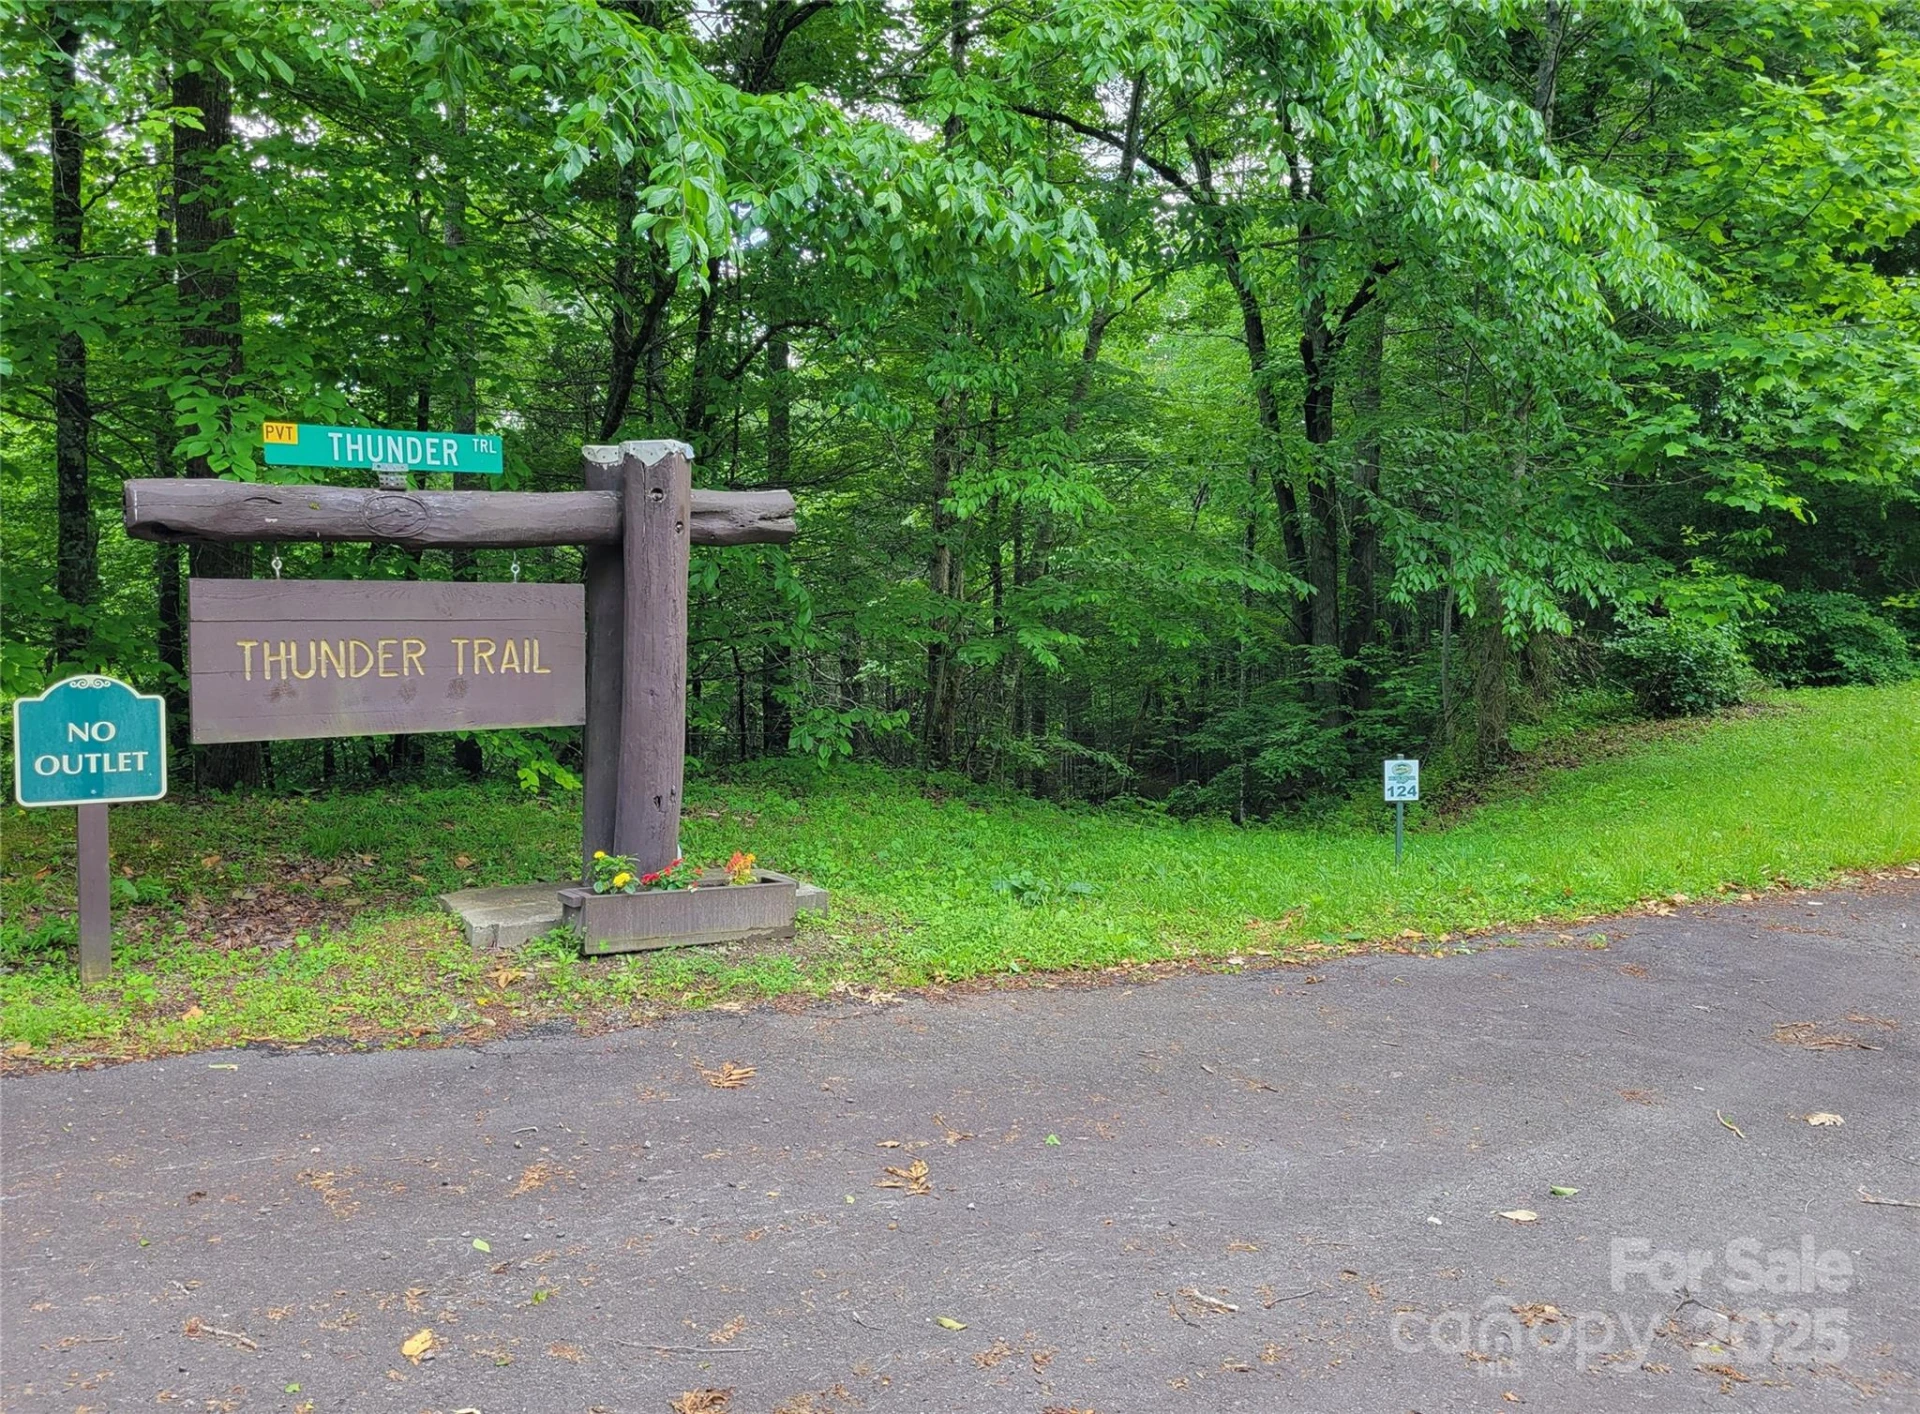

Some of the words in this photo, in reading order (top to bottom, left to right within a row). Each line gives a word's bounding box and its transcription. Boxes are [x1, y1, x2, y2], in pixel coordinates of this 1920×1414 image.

[265, 424, 294, 441] PVT
[327, 432, 459, 466] THUNDER
[472, 438, 497, 454] TRL
[236, 638, 427, 681] THUNDER
[451, 638, 552, 676] TRAIL
[68, 721, 116, 742] NO
[34, 751, 149, 776] OUTLET
[1387, 785, 1417, 797] 124
